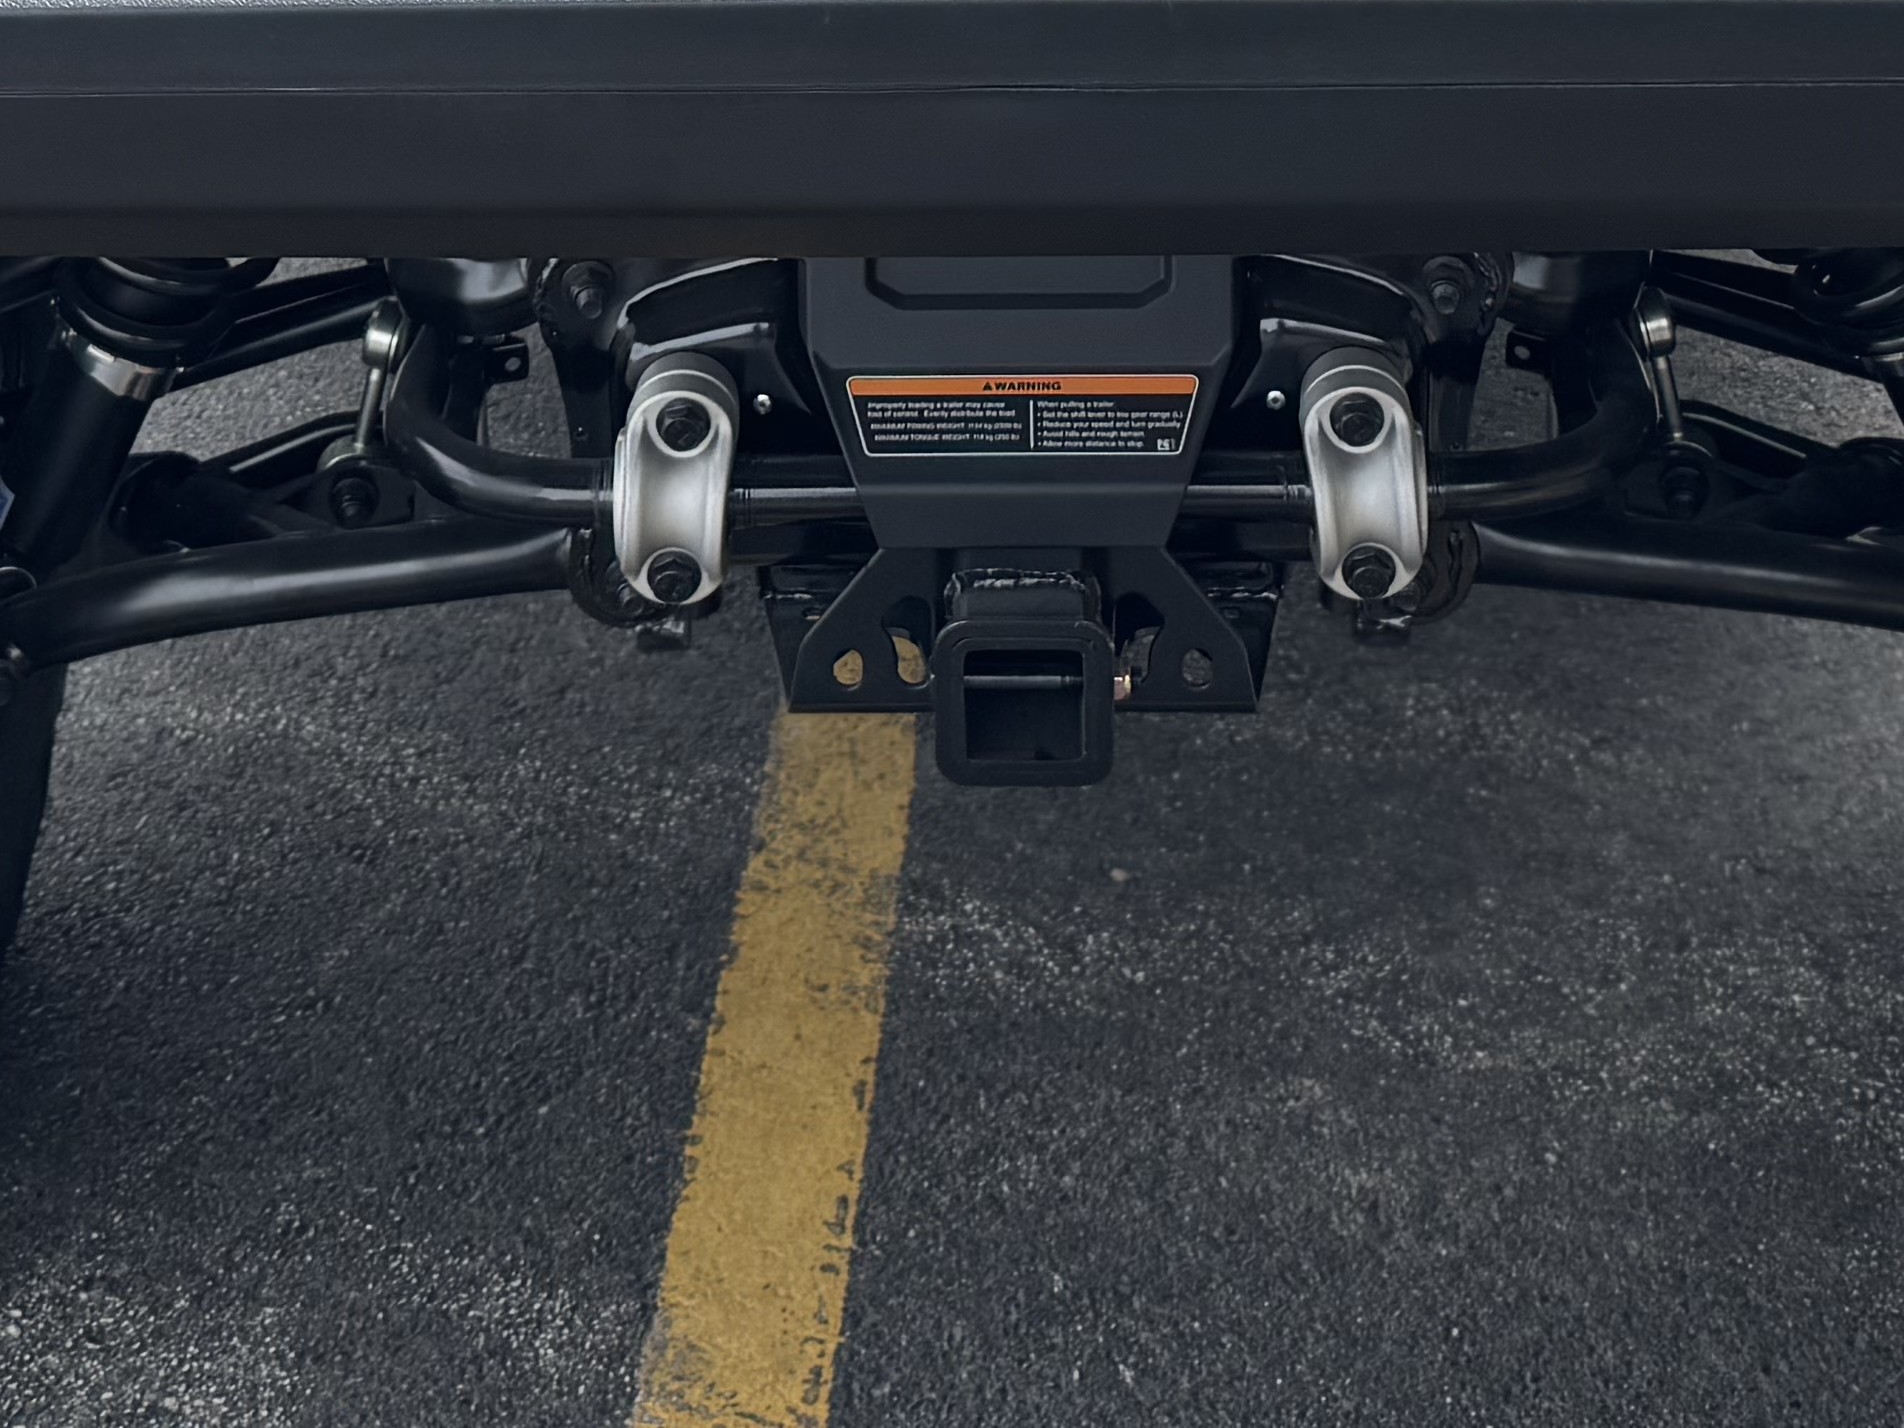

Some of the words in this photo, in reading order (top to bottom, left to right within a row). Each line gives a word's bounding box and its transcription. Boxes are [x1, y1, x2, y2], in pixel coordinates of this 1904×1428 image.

[994, 381, 1062, 391] WARNING
[1060, 401, 1085, 409] pulling
[924, 410, 949, 419] Evenly
[1149, 411, 1170, 419] range
[984, 422, 992, 430] kg
